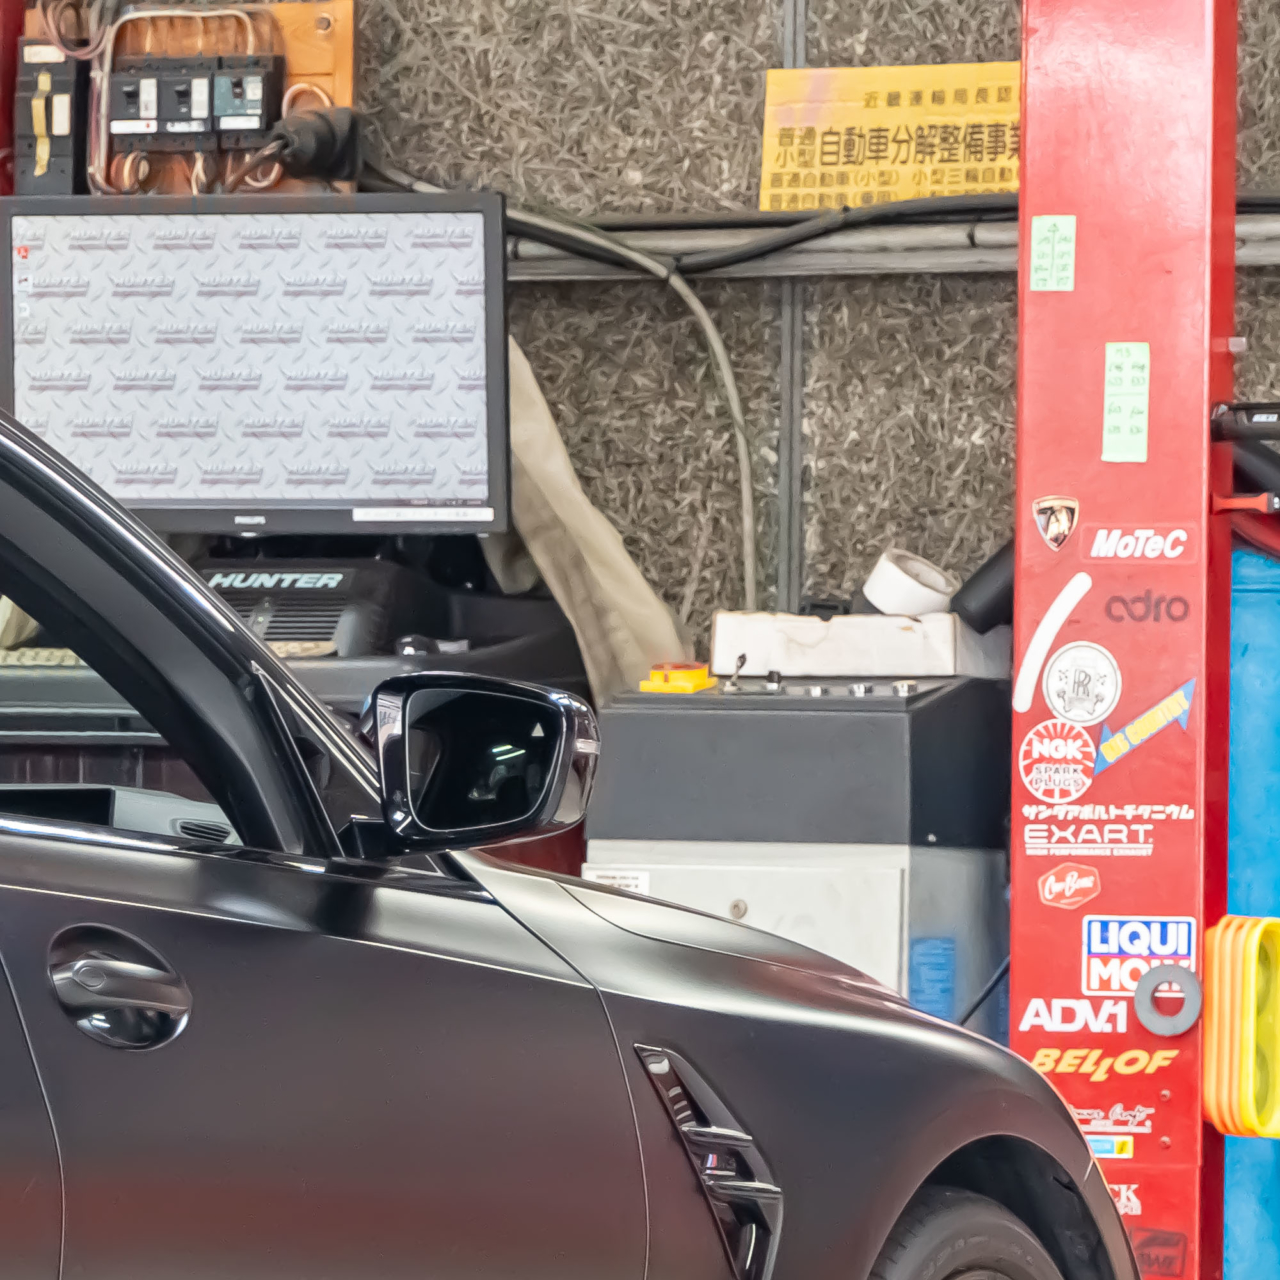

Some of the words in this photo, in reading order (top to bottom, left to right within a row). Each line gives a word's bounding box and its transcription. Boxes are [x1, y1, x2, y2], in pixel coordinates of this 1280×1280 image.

[1090, 529, 1188, 558] MoTeC
[209, 573, 343, 588] HUNTER
[1105, 589, 1189, 623] adro
[1031, 737, 1083, 760] NGK
[1034, 766, 1081, 776] SPARK
[1034, 778, 1081, 788] PLUGS
[1024, 824, 1154, 844] EXART
[1089, 921, 1189, 956] LIQUI
[1031, 1048, 1179, 1082] BELLOF
